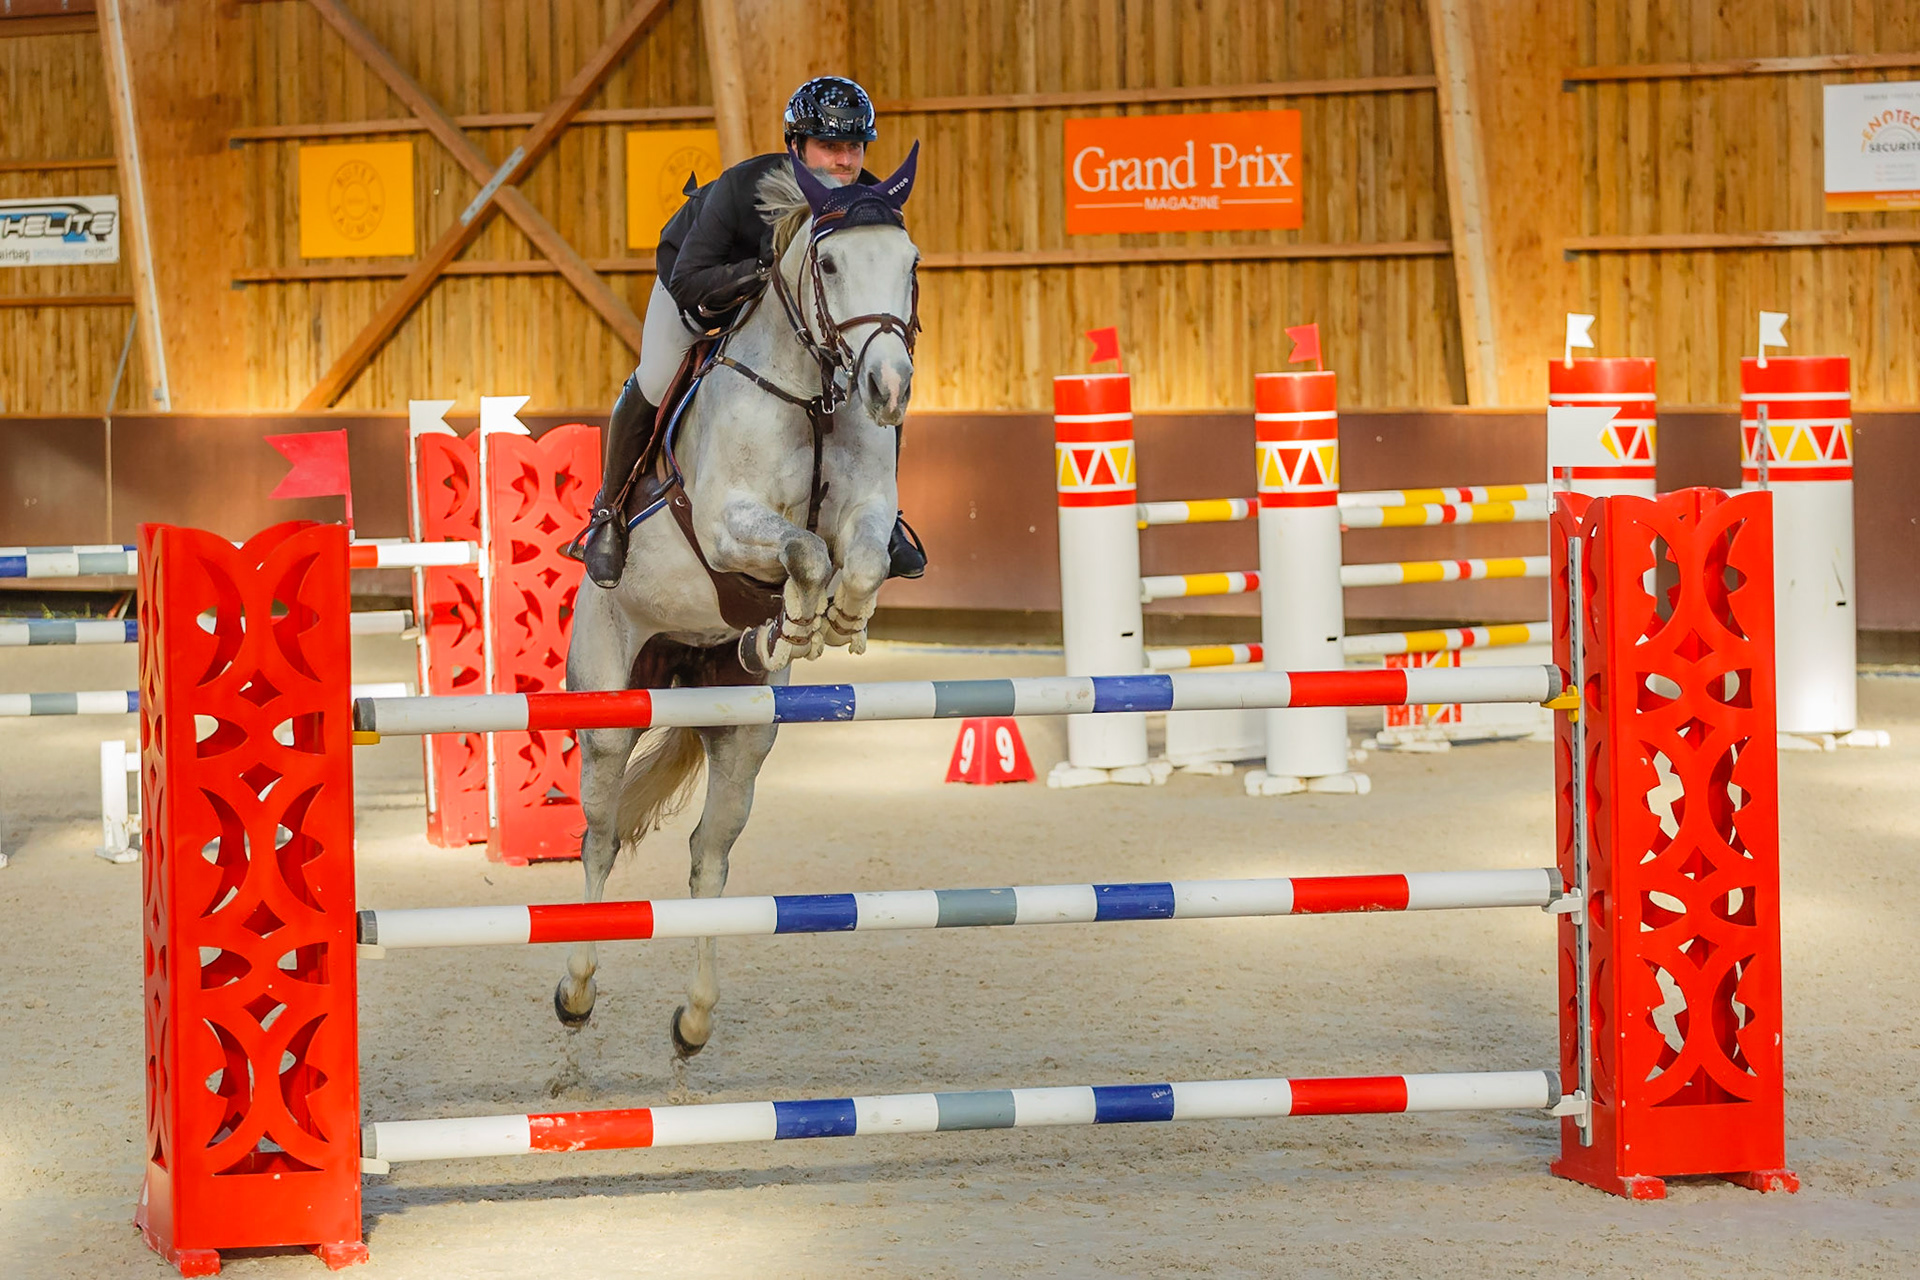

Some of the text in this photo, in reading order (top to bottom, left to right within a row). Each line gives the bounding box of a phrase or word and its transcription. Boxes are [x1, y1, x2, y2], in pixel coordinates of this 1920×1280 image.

[1073, 140, 1294, 192] Grand Prix
[2, 211, 116, 238] HELITE
[1144, 195, 1220, 210] MAGAZINE
[959, 727, 975, 774] 9
[995, 726, 1015, 773] 9
